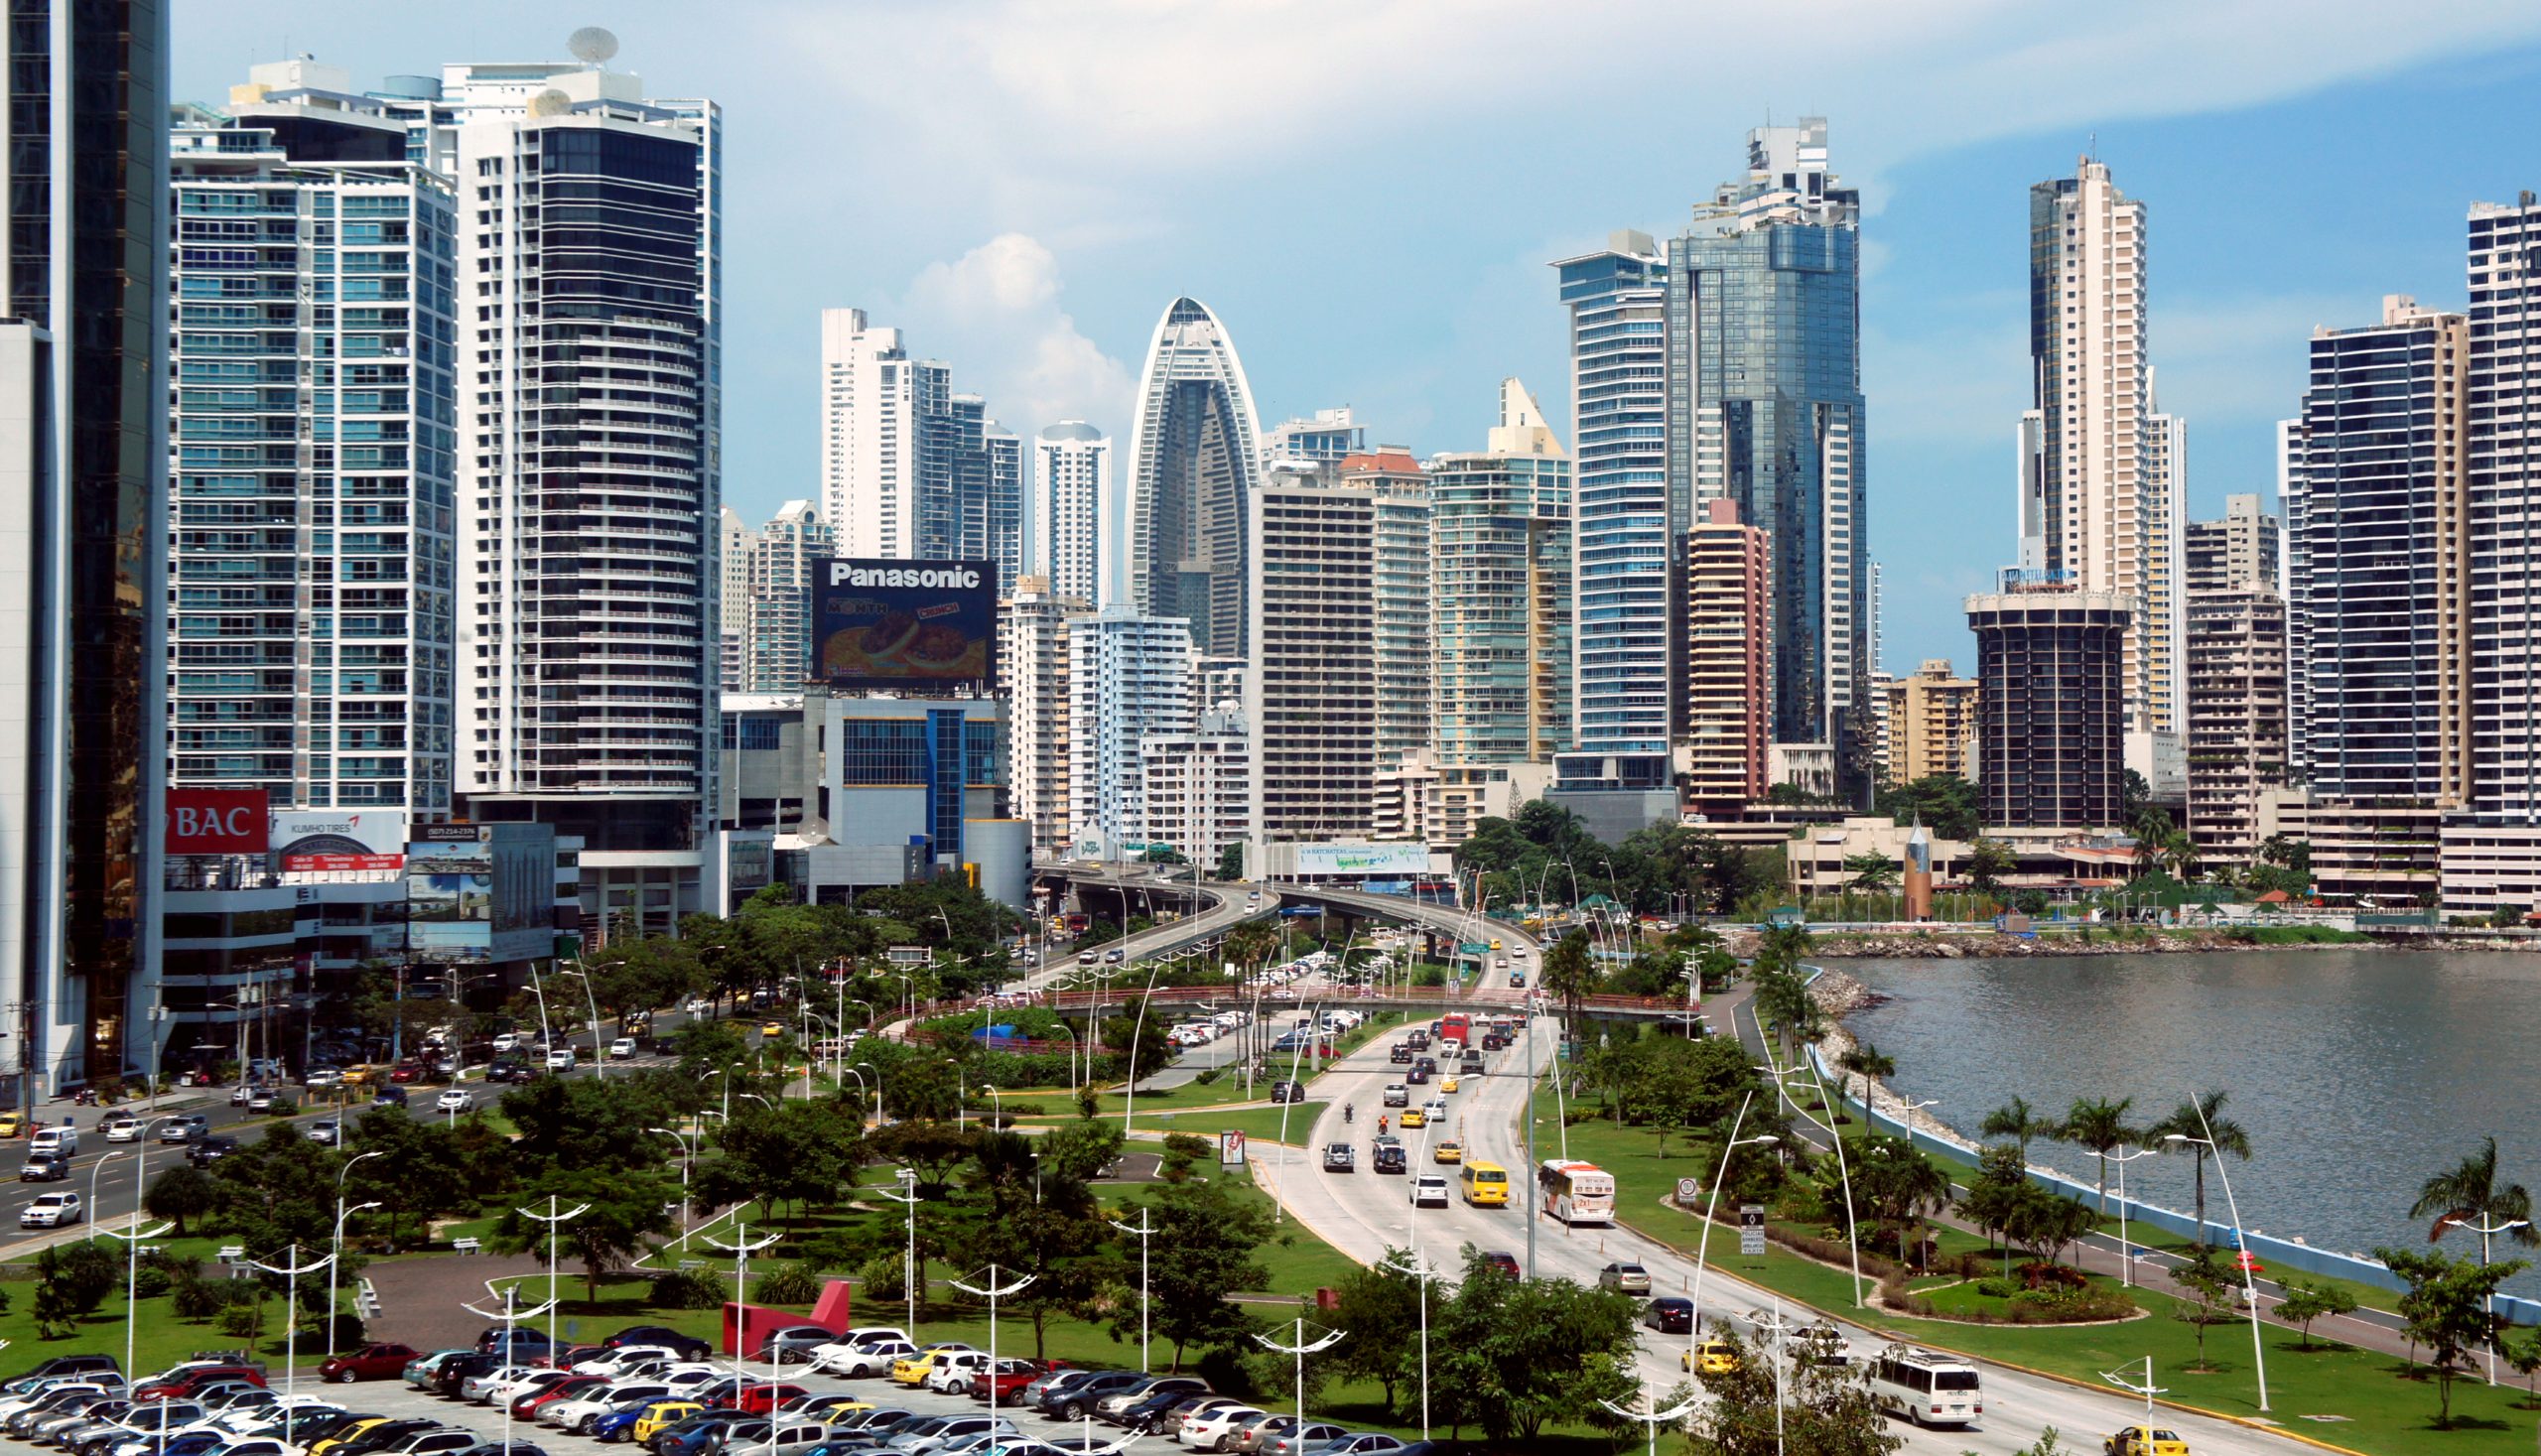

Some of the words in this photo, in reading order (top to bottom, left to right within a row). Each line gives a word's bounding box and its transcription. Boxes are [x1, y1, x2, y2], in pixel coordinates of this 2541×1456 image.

[830, 562, 980, 589] Panasonic
[919, 602, 959, 617] CRUNCH
[175, 807, 250, 837] BAC
[291, 824, 325, 834] KUMHO
[326, 824, 350, 833] TIRES
